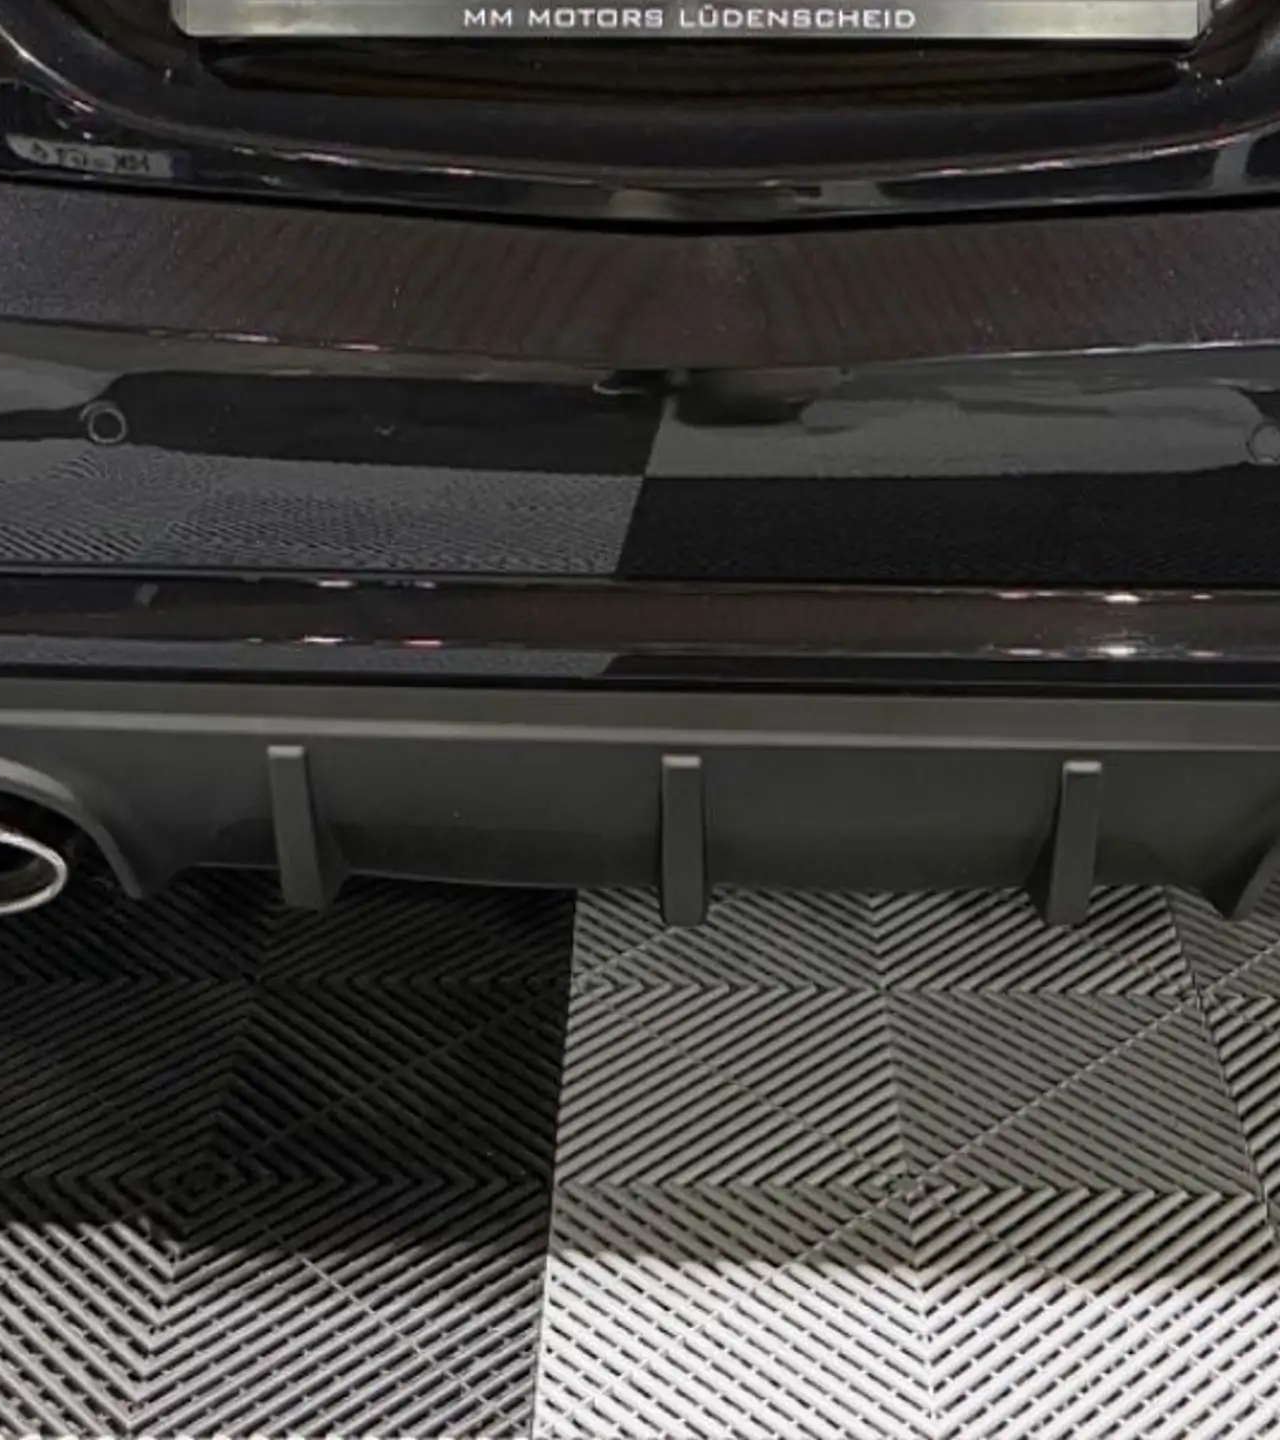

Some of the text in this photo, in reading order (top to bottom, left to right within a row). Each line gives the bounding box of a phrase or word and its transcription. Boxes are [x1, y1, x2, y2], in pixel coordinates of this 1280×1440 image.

[463, 3, 918, 29] MM MOTORS LÜDENSCHEID
